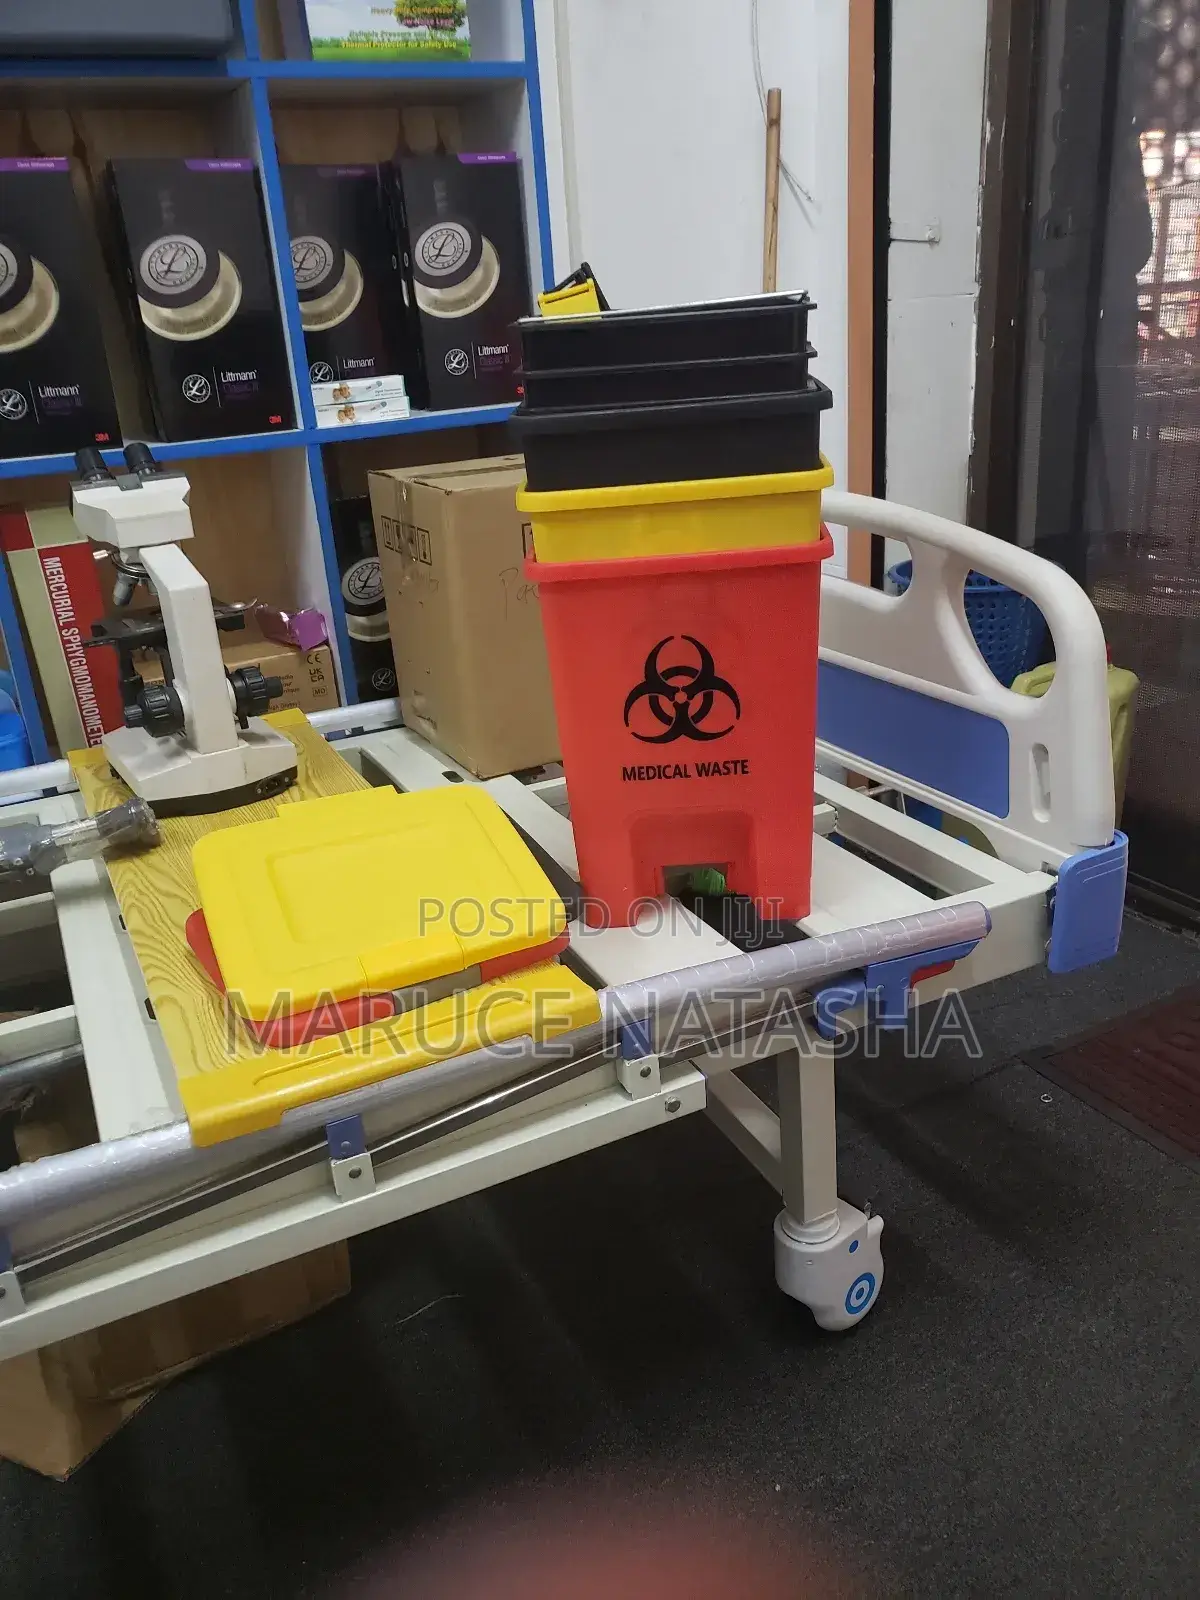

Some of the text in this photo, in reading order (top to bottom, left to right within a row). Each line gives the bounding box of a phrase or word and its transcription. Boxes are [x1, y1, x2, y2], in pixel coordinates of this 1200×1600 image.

[477, 344, 509, 356] Littmann
[342, 358, 375, 369] Littmann
[220, 370, 257, 383] Littmann
[38, 384, 80, 398] Littmann
[268, 415, 282, 424] 3M
[94, 432, 110, 442] 3M
[42, 556, 104, 748] MERCURIAL SPHYGMOMANOMETE
[309, 667, 323, 675] UK
[622, 759, 750, 782] MEDICAL WASTE
